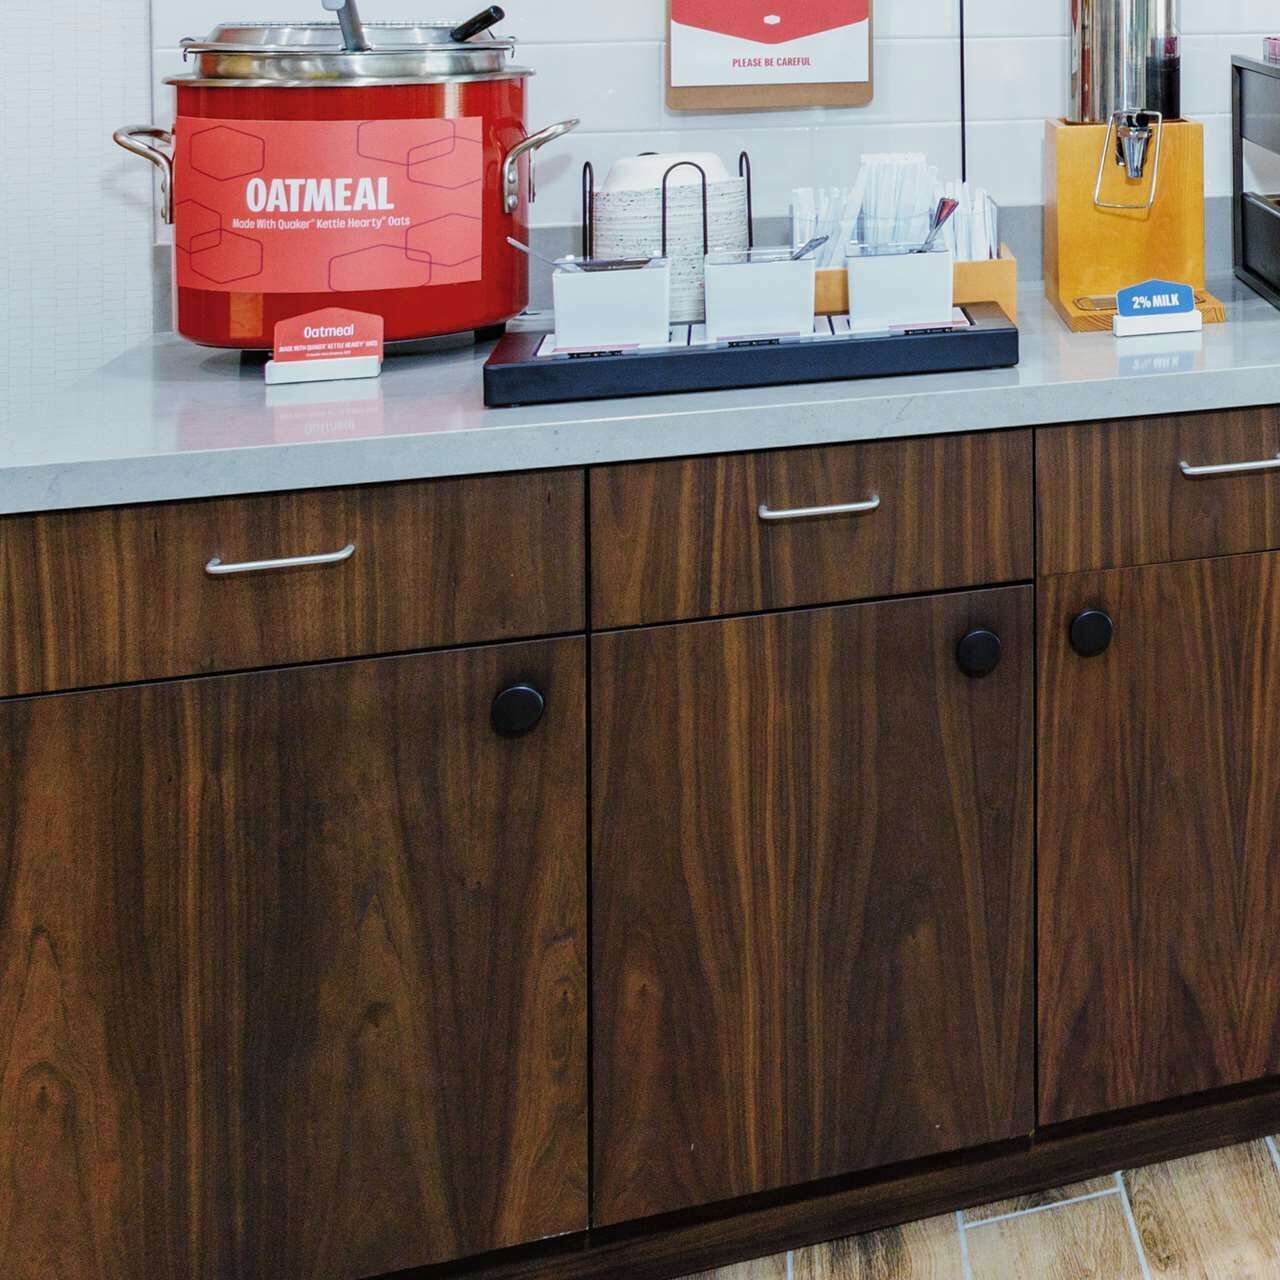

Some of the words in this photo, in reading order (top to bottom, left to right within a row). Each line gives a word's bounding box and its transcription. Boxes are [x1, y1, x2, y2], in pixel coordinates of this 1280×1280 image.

[732, 58, 762, 68] PLEASE
[764, 58, 774, 67] BE
[776, 57, 811, 66] CAREFUL
[246, 176, 395, 212] OATMEAL
[232, 218, 255, 229] Made
[256, 218, 276, 229] With
[316, 218, 346, 229] Kettle
[388, 215, 410, 226] Oats
[1132, 296, 1152, 309] 2%
[1152, 293, 1180, 308] MILK
[304, 323, 354, 338] Oatmeal
